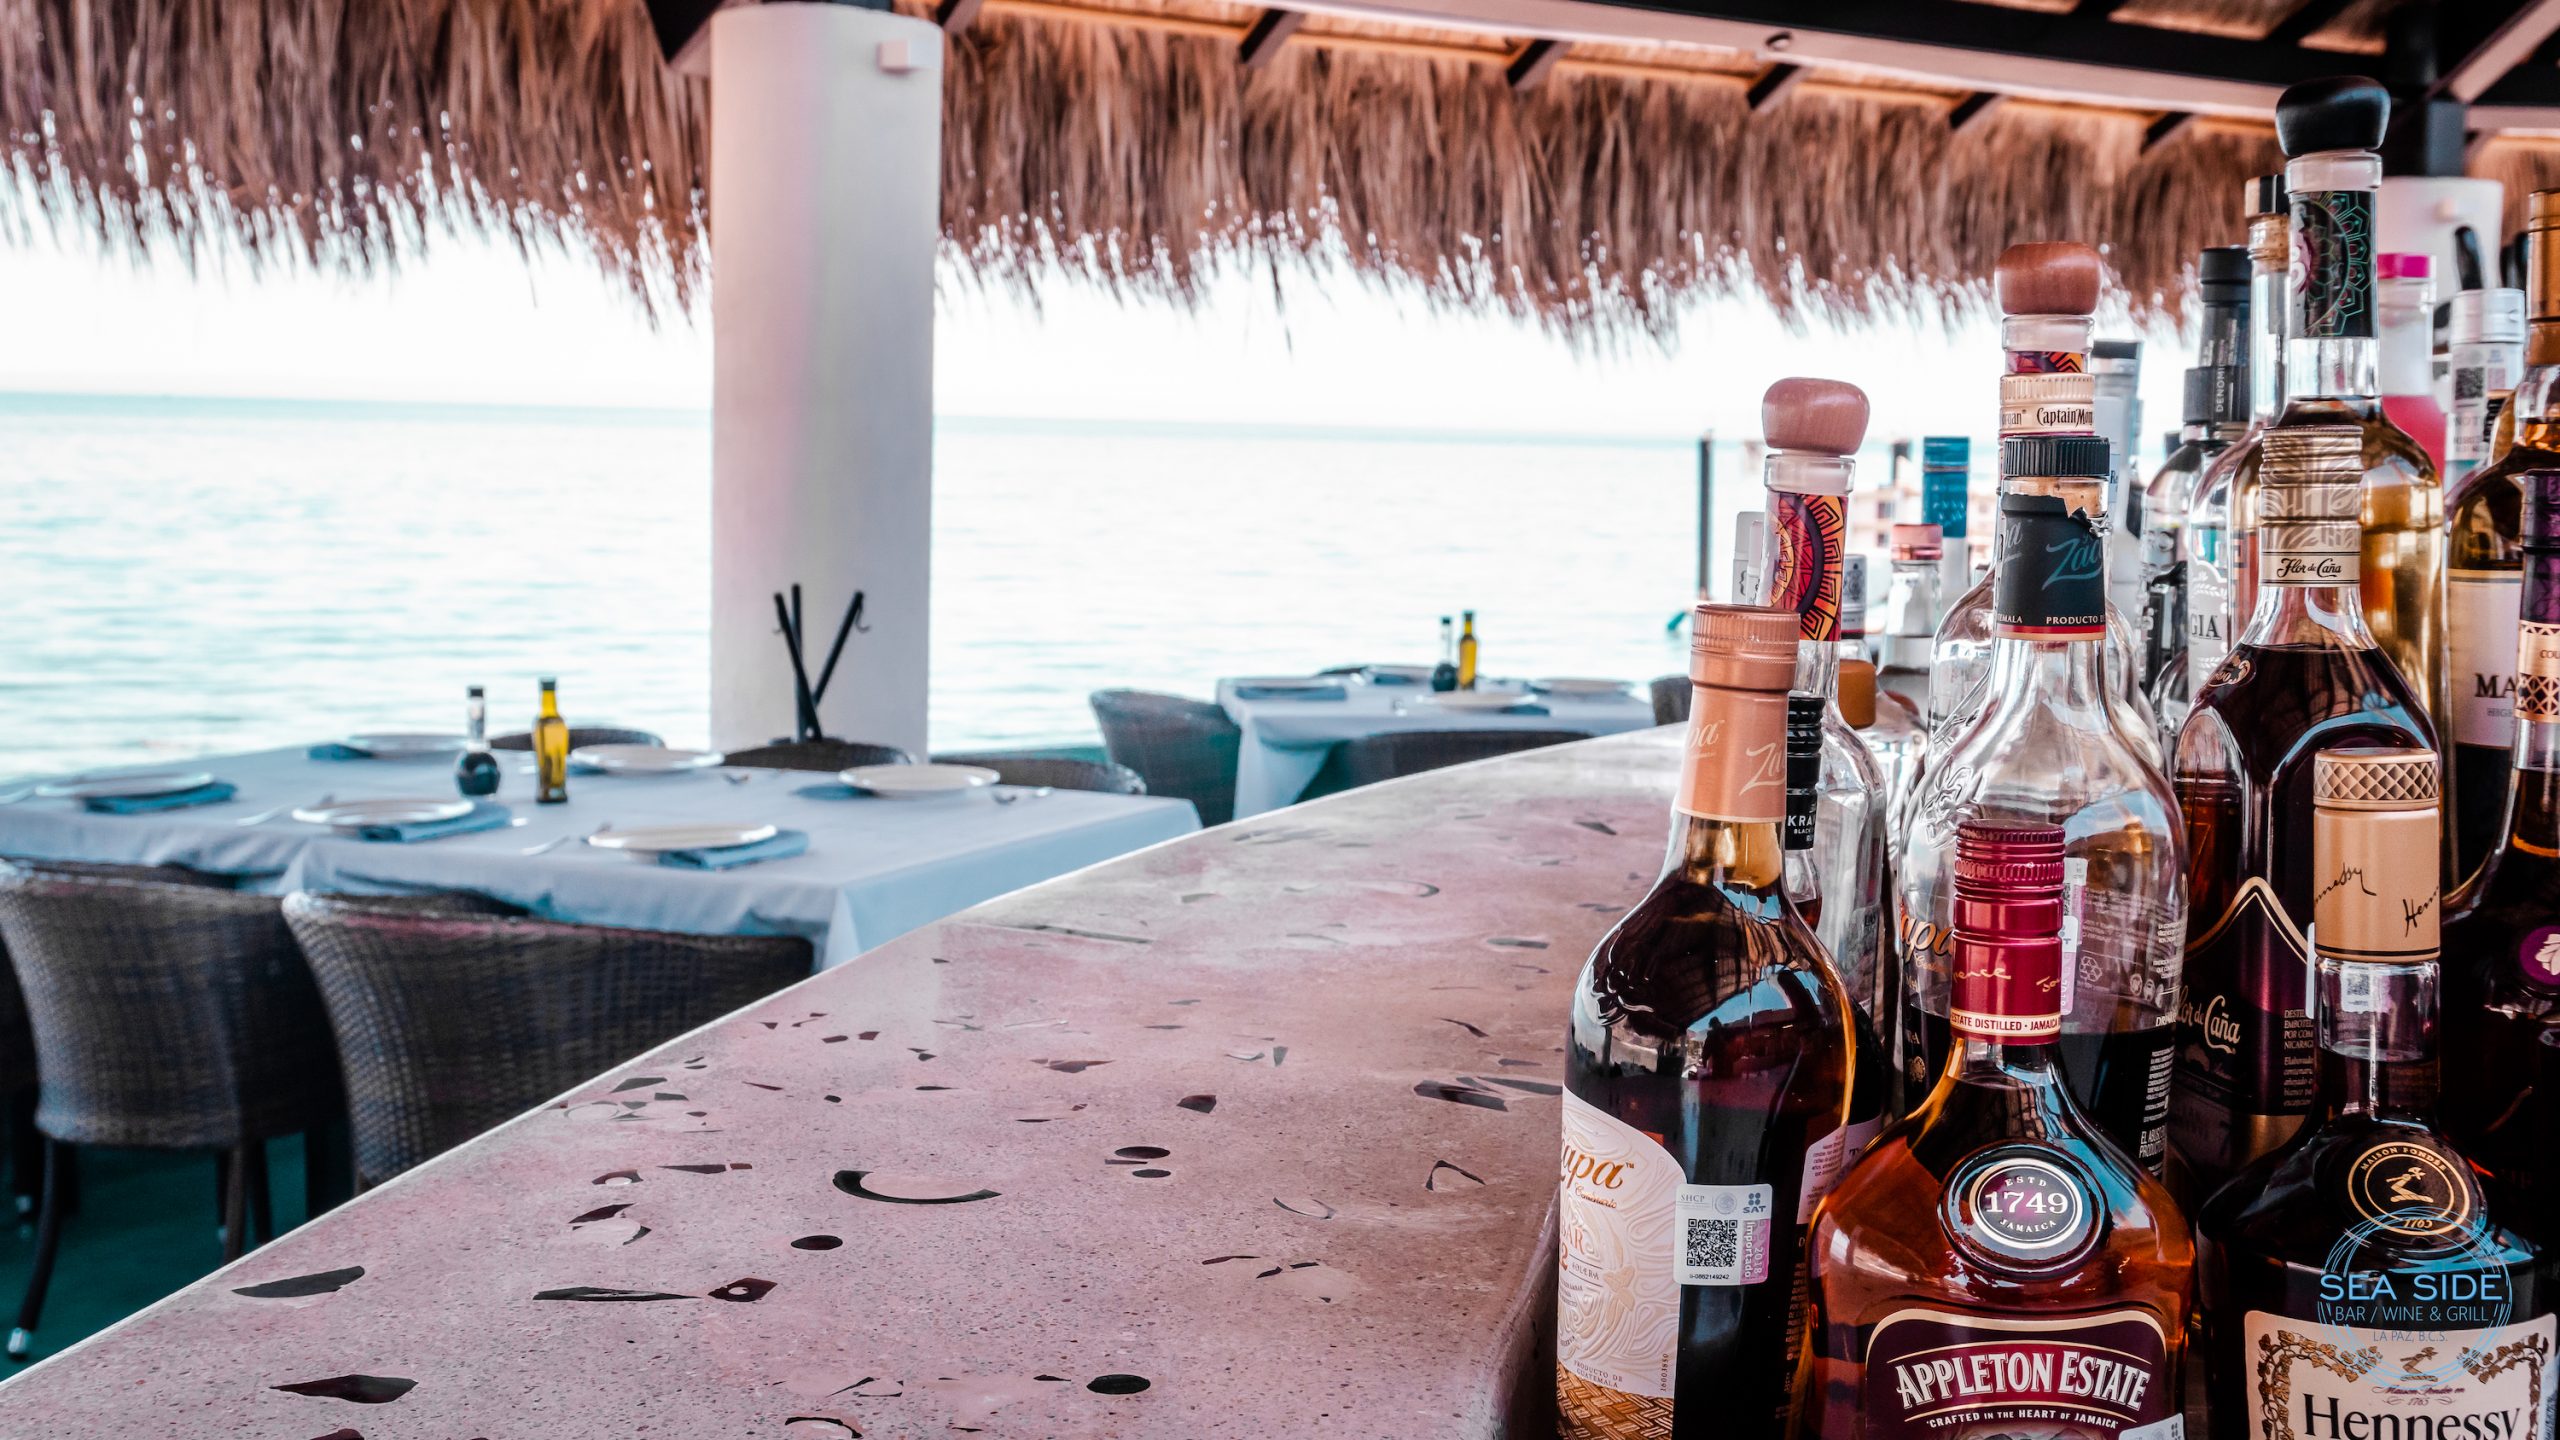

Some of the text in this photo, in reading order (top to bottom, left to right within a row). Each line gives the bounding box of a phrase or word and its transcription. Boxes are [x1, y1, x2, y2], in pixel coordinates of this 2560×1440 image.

[2277, 558, 2306, 578] Flor
[2317, 557, 2342, 578] Caña
[2046, 614, 2099, 625] PRODUCTO
[1974, 1018, 2022, 1031] DISTILLED
[2204, 994, 2241, 1055] Caña
[2361, 1147, 2399, 1171] MAISON
[2004, 1176, 2048, 1188] ESTD
[1742, 1205, 1767, 1214] SAT
[1984, 1190, 2069, 1214] 1749
[1999, 1218, 2058, 1233] JAMAICA
[1743, 1221, 1755, 1279] Importado
[1754, 1247, 1764, 1275] 2018
[1573, 1360, 1623, 1383] PRODUCTO DE
[1576, 1368, 1618, 1388] GUATEMALA
[1896, 1350, 2151, 1411] APPLETON ESTATE
[1984, 1412, 1994, 1420] IN
[1997, 1411, 2014, 1419] THE
[2018, 1409, 2057, 1419] HEART
[2060, 1412, 2071, 1420] OF
[2302, 1393, 2521, 1440] Hennessy
